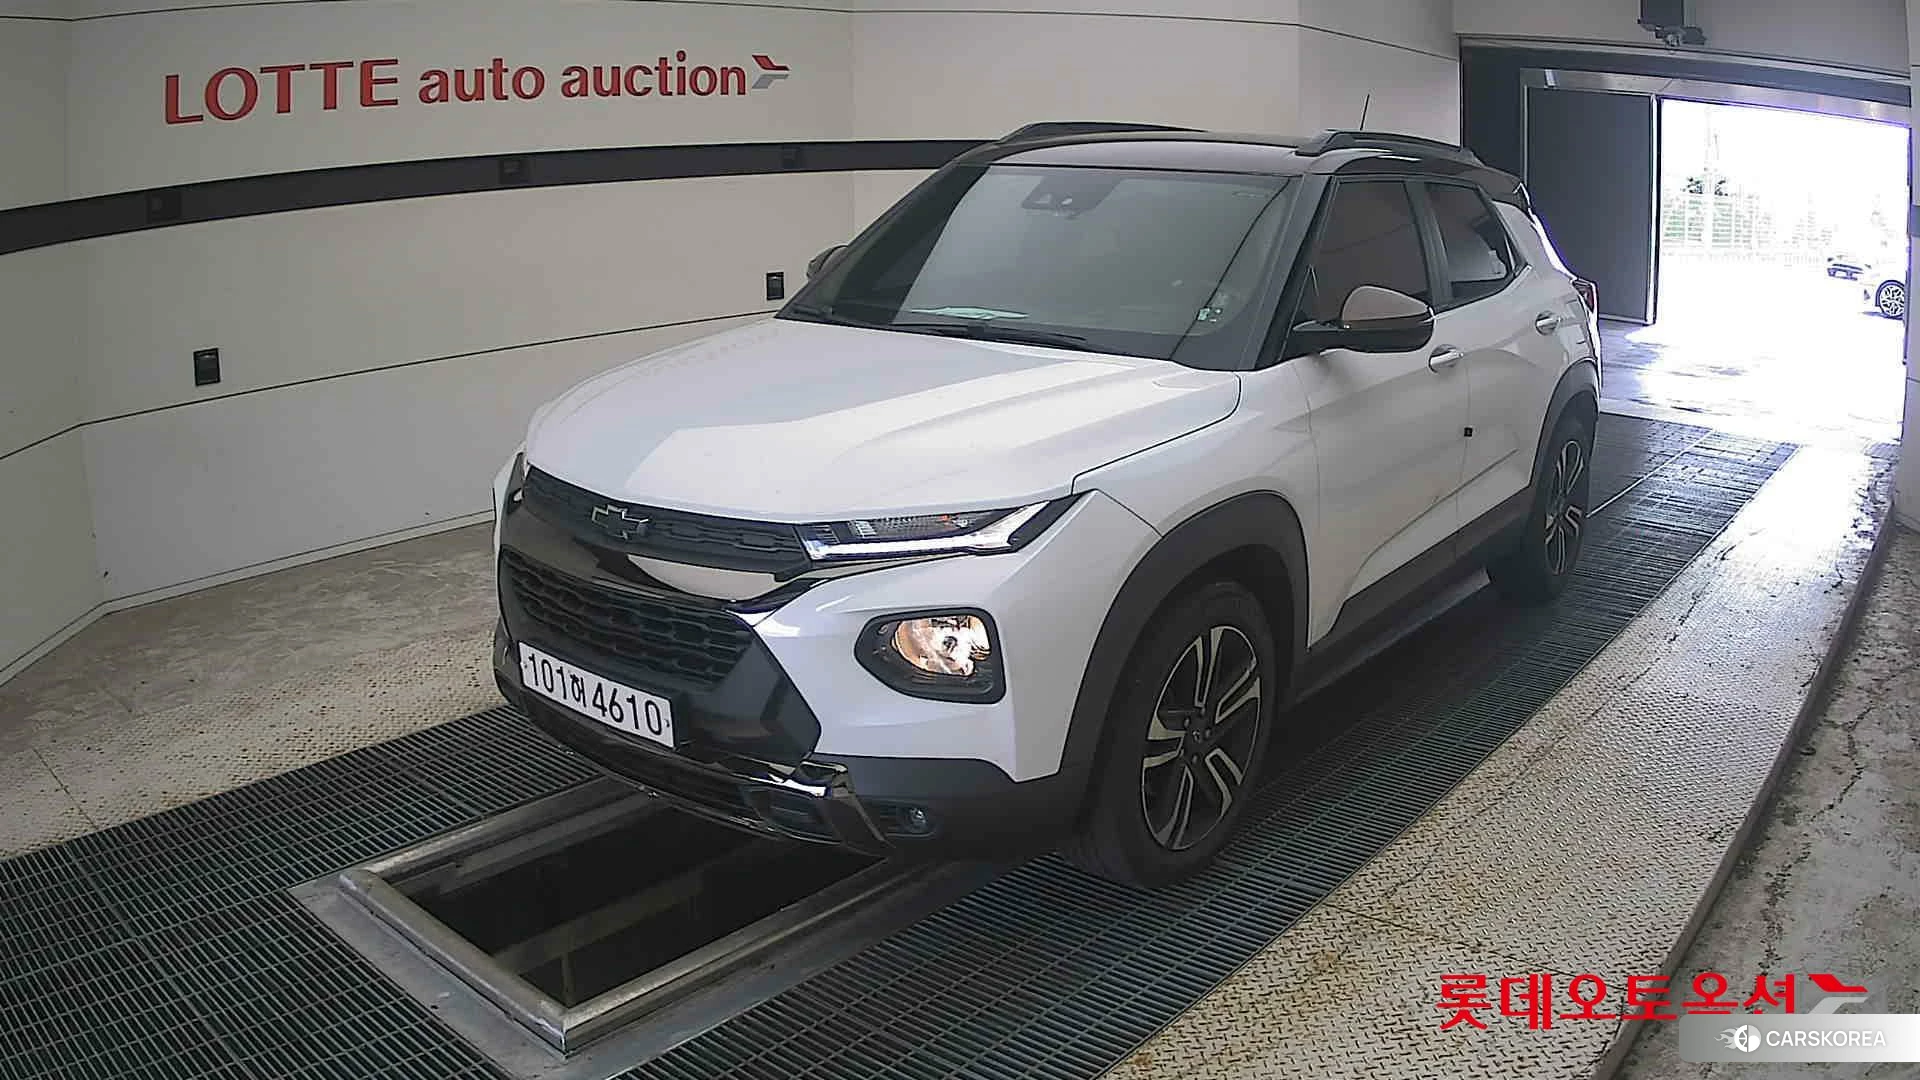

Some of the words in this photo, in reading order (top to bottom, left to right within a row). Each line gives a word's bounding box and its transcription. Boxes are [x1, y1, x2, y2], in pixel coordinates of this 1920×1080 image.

[165, 58, 398, 124] LOTTE
[418, 57, 546, 103] auto
[561, 50, 747, 98] auction
